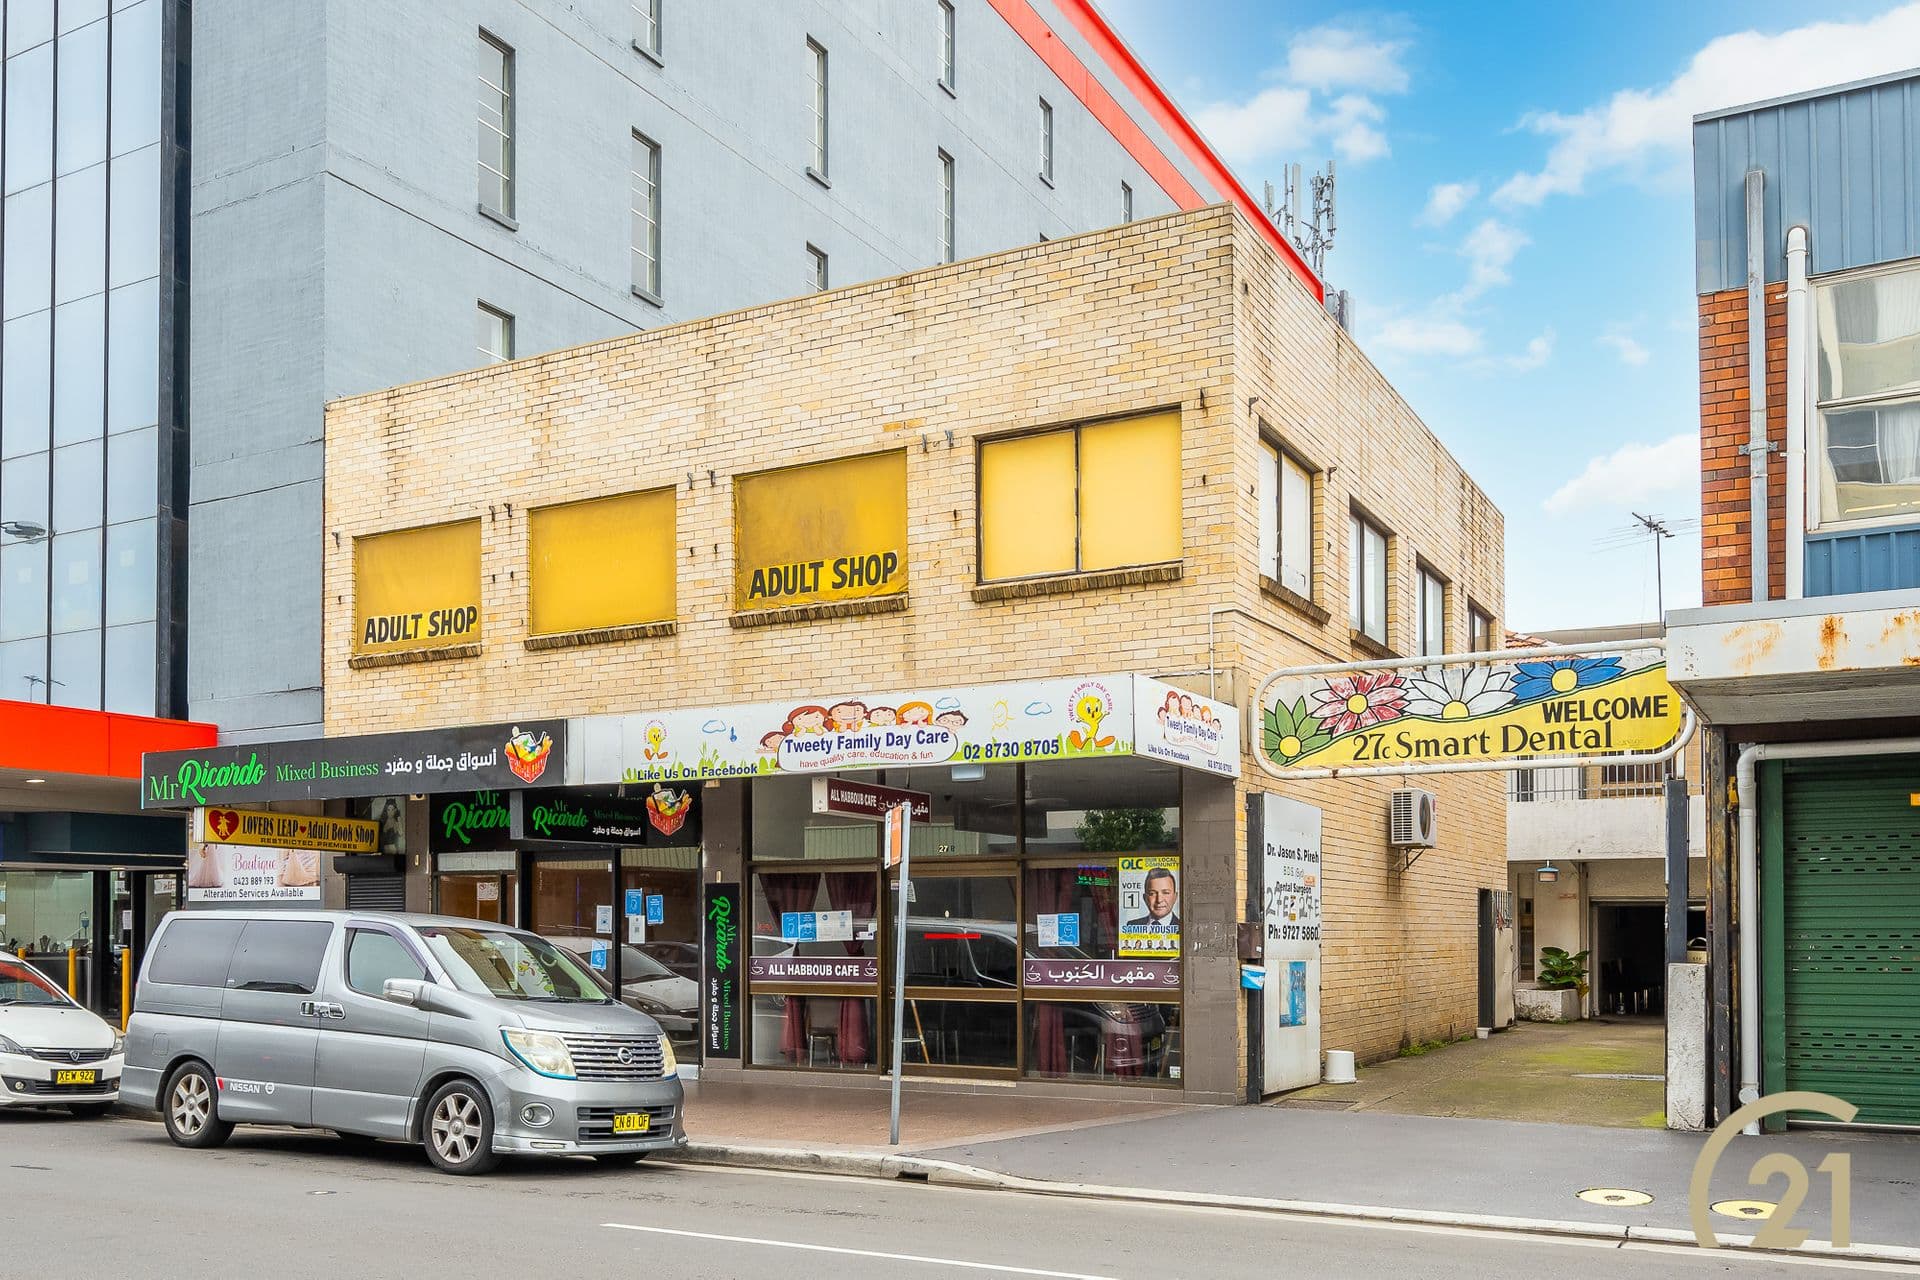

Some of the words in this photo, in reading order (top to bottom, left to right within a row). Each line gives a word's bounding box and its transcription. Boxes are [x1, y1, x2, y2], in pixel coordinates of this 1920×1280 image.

[749, 561, 824, 600] ADULT
[831, 551, 898, 590] SHOP
[364, 613, 423, 644] ADULT
[427, 605, 478, 637] SHOP
[1542, 695, 1668, 724] WELCOME
[785, 739, 833, 755] Tweety
[837, 733, 882, 752] Family
[886, 732, 912, 750] Day
[916, 729, 950, 745] Care
[1395, 729, 1490, 759] Smart
[1501, 720, 1612, 753] Dental
[963, 744, 981, 760] 02
[985, 741, 1019, 758] 8730
[1024, 738, 1060, 755] 8705
[384, 754, 412, 775] مفرد
[416, 760, 422, 774] و
[425, 754, 453, 772] جملة
[799, 759, 819, 769] have
[819, 752, 846, 767] quality
[869, 749, 910, 761] education
[911, 751, 918, 760] &
[920, 751, 934, 759] fun
[149, 775, 178, 801] Mr
[178, 752, 268, 805] Ricardo
[275, 761, 316, 782] Mixed
[320, 760, 379, 778] Business
[637, 769, 660, 781] Like
[664, 767, 679, 780] Us
[682, 766, 698, 778] On
[701, 763, 758, 777] Facebook
[475, 790, 500, 806] Mr
[554, 800, 568, 811] Mr
[830, 789, 840, 802] ALL
[840, 790, 864, 806] HABBOUB
[864, 794, 877, 807] CAFE
[442, 802, 510, 844] Ricar
[532, 806, 589, 836] Ricardo
[242, 815, 274, 836] LOVERS
[277, 817, 298, 837] LEAP
[307, 820, 330, 840] Adult
[331, 823, 353, 842] Book
[355, 824, 375, 846] Shop
[260, 837, 313, 847] RESTRICTED
[317, 841, 358, 849] PREMISES
[939, 845, 949, 853] 27
[1266, 843, 1277, 857] Dr.
[1278, 845, 1296, 860] Jason
[1296, 848, 1304, 861] S.
[1304, 849, 1320, 864] Pireh
[233, 852, 276, 874] Boutique
[1121, 859, 1143, 870] OLC
[233, 877, 249, 886] 0423
[250, 877, 263, 886] 889
[263, 877, 274, 886] 193
[1276, 881, 1293, 893] Dental
[1293, 883, 1311, 896] Surgeon
[203, 890, 237, 899] Alteration
[239, 889, 270, 898] Services
[270, 888, 304, 898] Available
[1127, 893, 1135, 908] 1
[708, 896, 732, 973] Ricardo
[727, 924, 737, 944] Mr
[1122, 925, 1148, 934] SAMIR
[1150, 925, 1179, 934] YOUSIF
[1268, 924, 1281, 940] Ph:
[1282, 925, 1300, 940] 9727
[768, 964, 785, 976] ALL
[788, 964, 832, 976] HABBOUB
[834, 964, 860, 976] CAFE
[1110, 967, 1155, 984] مقهى
[723, 979, 731, 1008] Mixed
[723, 1010, 731, 1051] Business
[59, 1071, 77, 1081] XEW
[80, 1071, 94, 1081] 922
[229, 1082, 260, 1094] NISSAN
[614, 1116, 625, 1129] CN
[626, 1115, 635, 1128] 81
